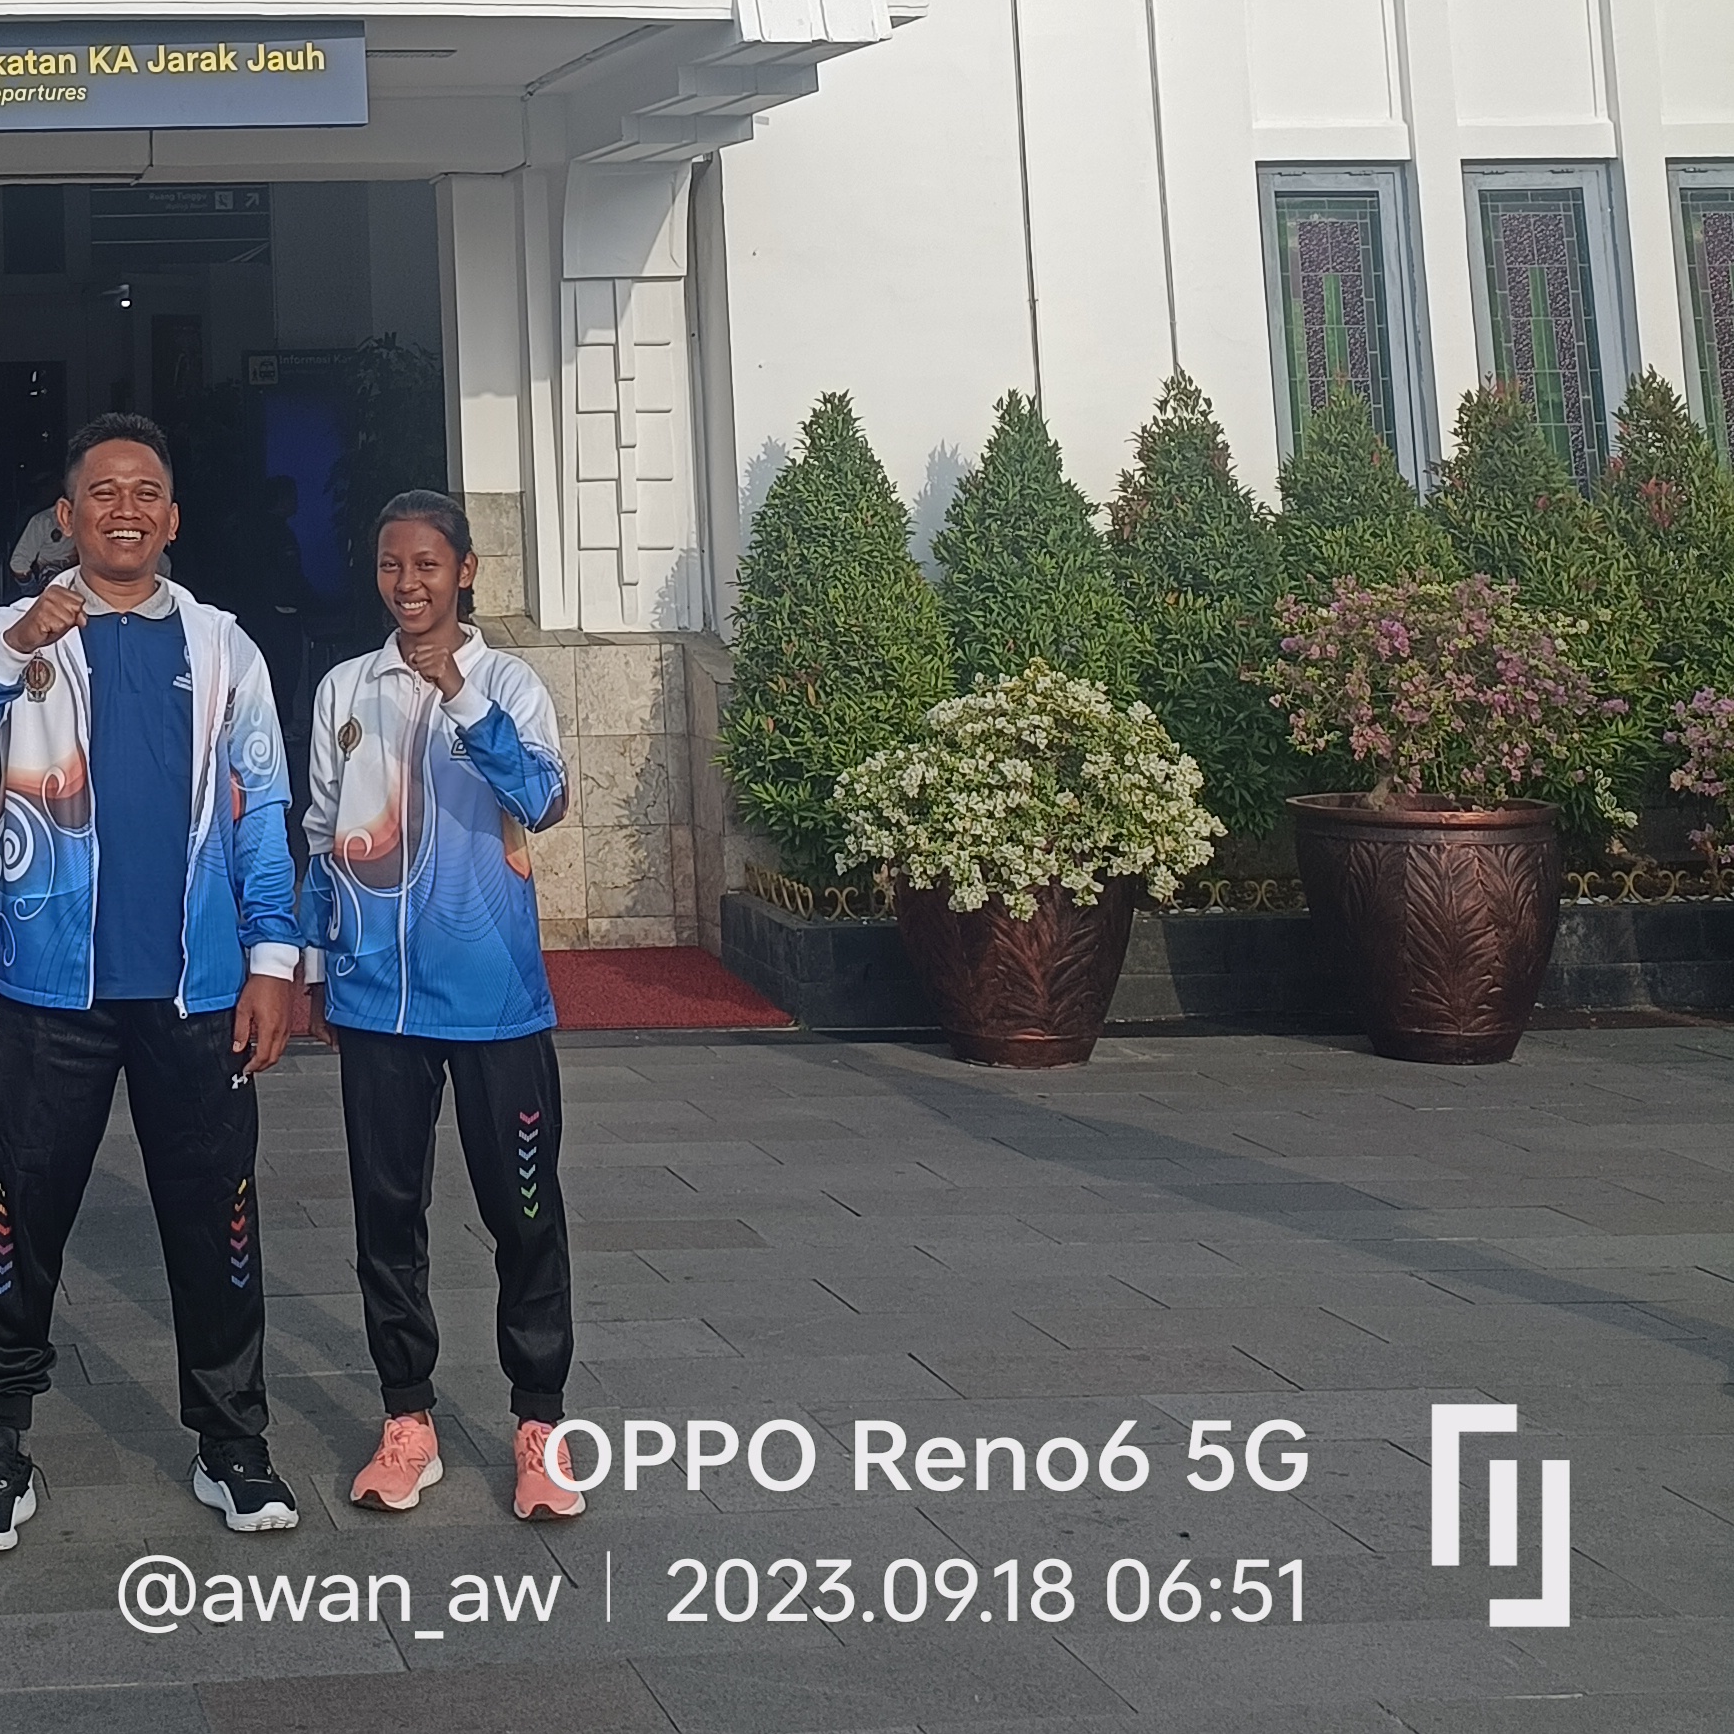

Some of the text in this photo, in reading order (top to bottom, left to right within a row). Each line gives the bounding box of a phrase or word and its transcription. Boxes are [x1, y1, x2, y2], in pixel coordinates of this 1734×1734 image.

[89, 44, 139, 74] KA
[146, 43, 238, 73] Jarak
[246, 42, 325, 72] Jauh
